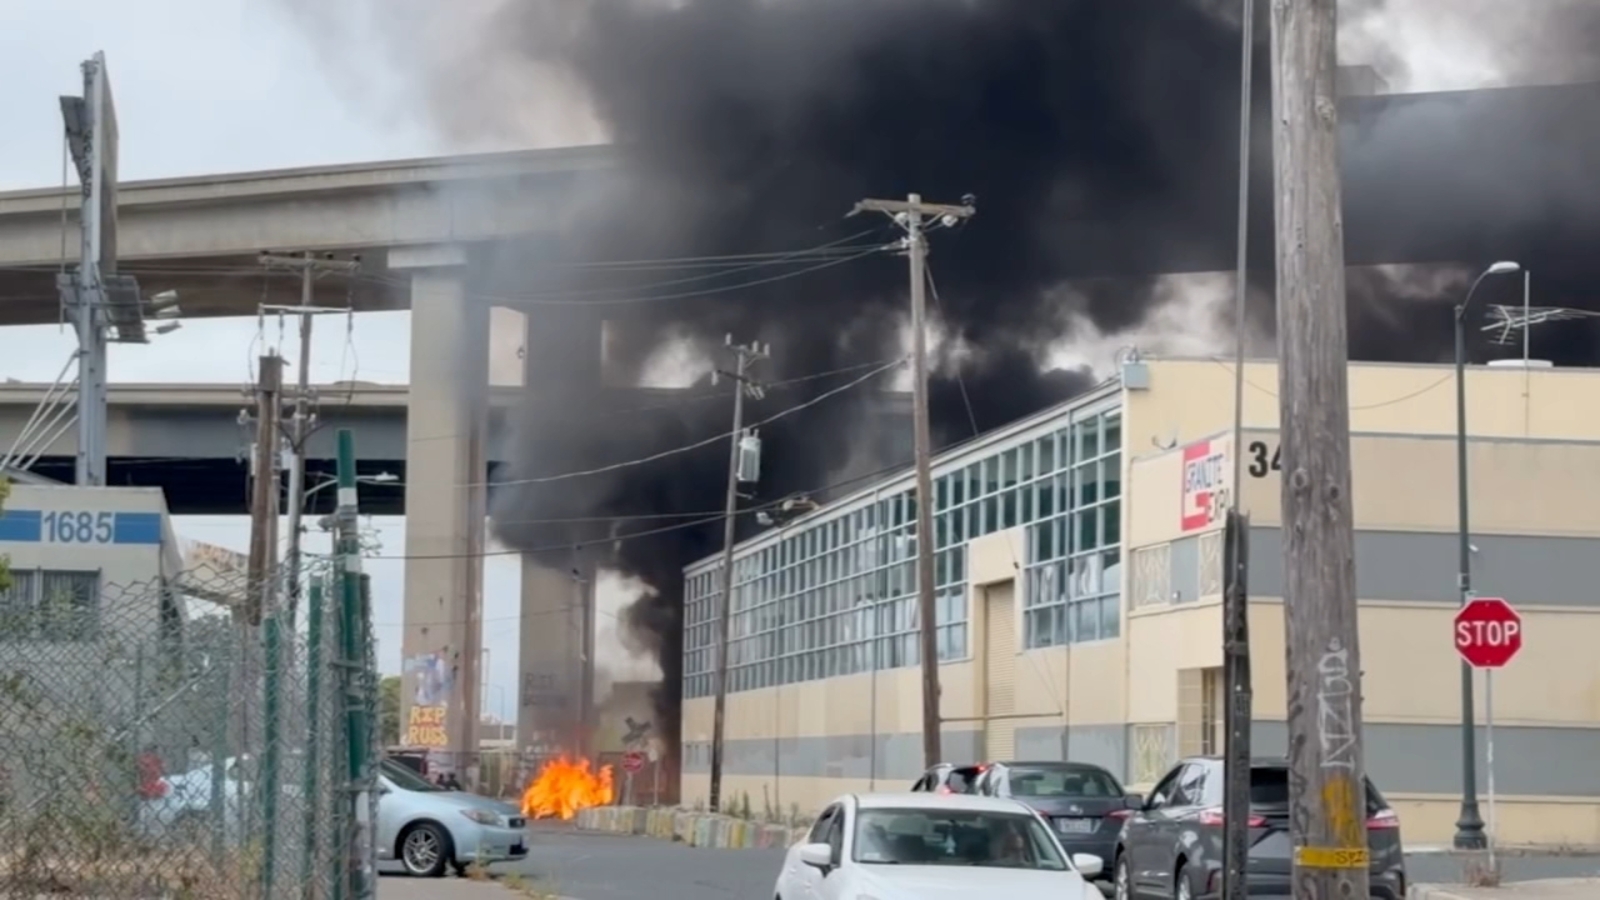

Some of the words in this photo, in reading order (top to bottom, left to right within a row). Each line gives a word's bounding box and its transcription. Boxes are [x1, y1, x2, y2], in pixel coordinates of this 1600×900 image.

[44, 511, 113, 543] 1685
[1457, 620, 1518, 646] STOP
[407, 725, 449, 746] RUSS
